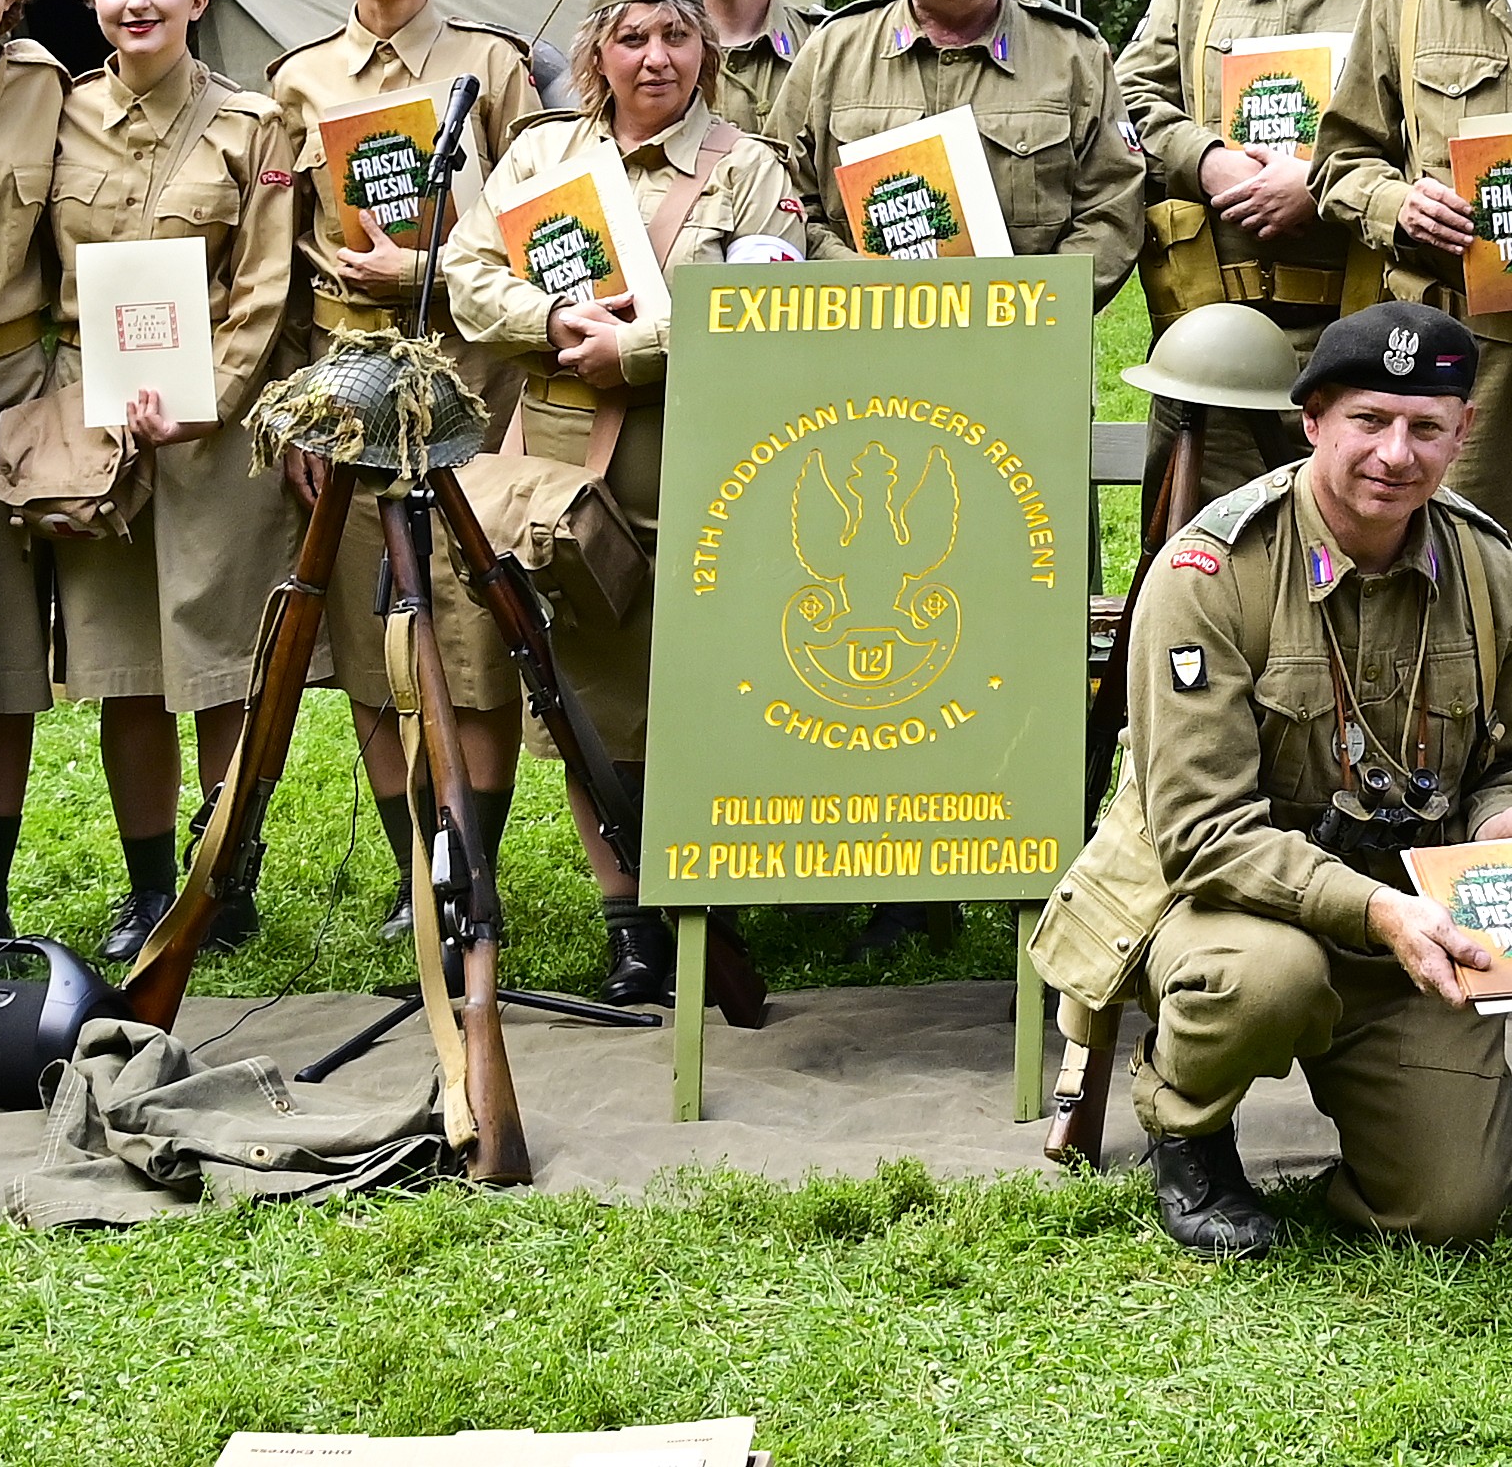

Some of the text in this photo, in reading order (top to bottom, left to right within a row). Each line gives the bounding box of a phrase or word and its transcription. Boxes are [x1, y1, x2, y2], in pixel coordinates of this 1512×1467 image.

[371, 196, 419, 226] TRENY
[708, 279, 1057, 333] EXHIBITION BY:
[693, 396, 1056, 596] 12TH PODOLIAN LANCERS REGIMENT
[1173, 552, 1216, 571] POLAND
[762, 699, 977, 751] CHICAGO, IL
[711, 793, 1012, 827] FOLLOW US ON FACEBOOK:
[665, 831, 1058, 880] 12 PUŁK UŁANÓW CHICAGO
